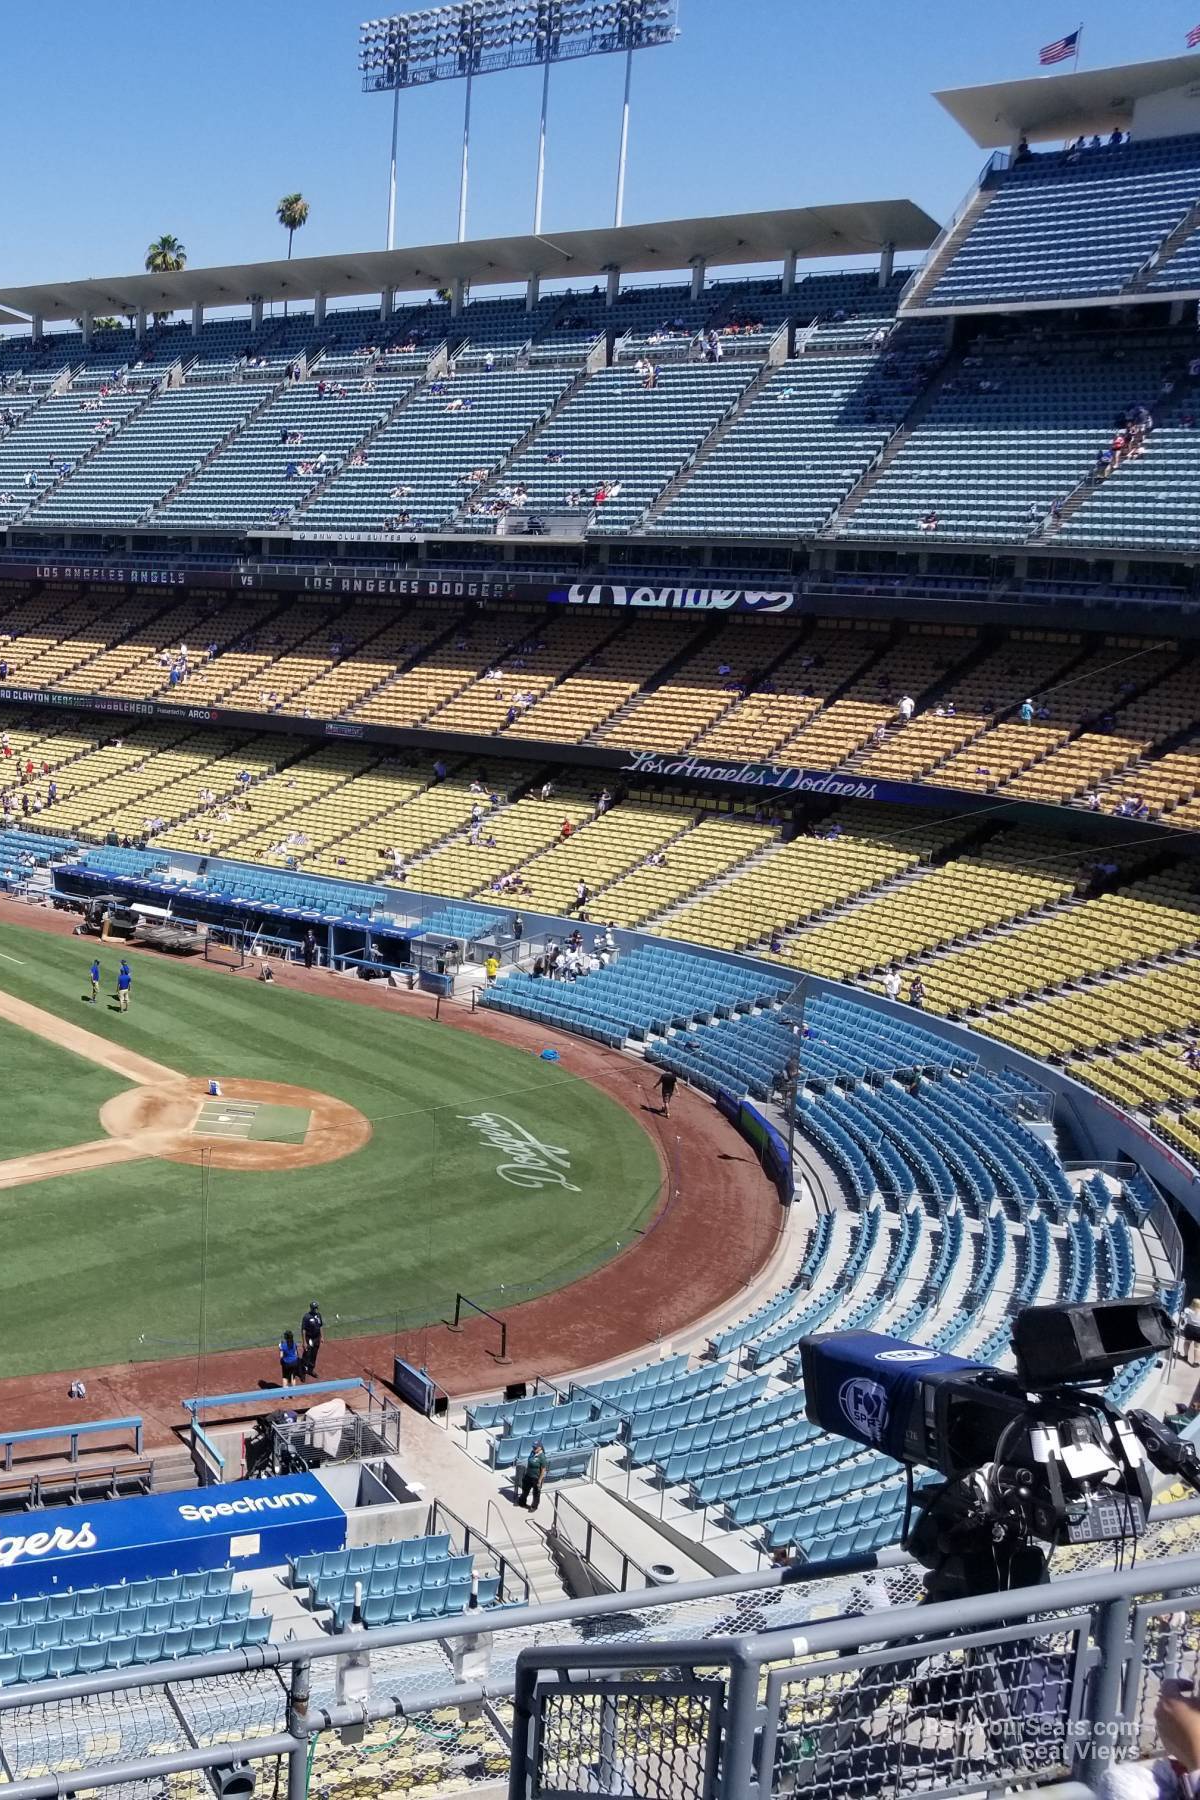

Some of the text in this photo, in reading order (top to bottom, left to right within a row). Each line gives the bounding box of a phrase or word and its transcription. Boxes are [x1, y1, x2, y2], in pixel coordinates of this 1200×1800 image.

[36, 567, 58, 577] LOS
[241, 576, 253, 586] VS
[305, 577, 332, 590] LOS
[341, 578, 418, 594] ANGELES
[13, 691, 50, 703] CLAYTON
[188, 709, 211, 720] ARCO
[620, 751, 878, 800] Los Angeles Dodgers
[456, 1112, 581, 1192] Dodgers
[178, 1492, 308, 1523] Spectrum
